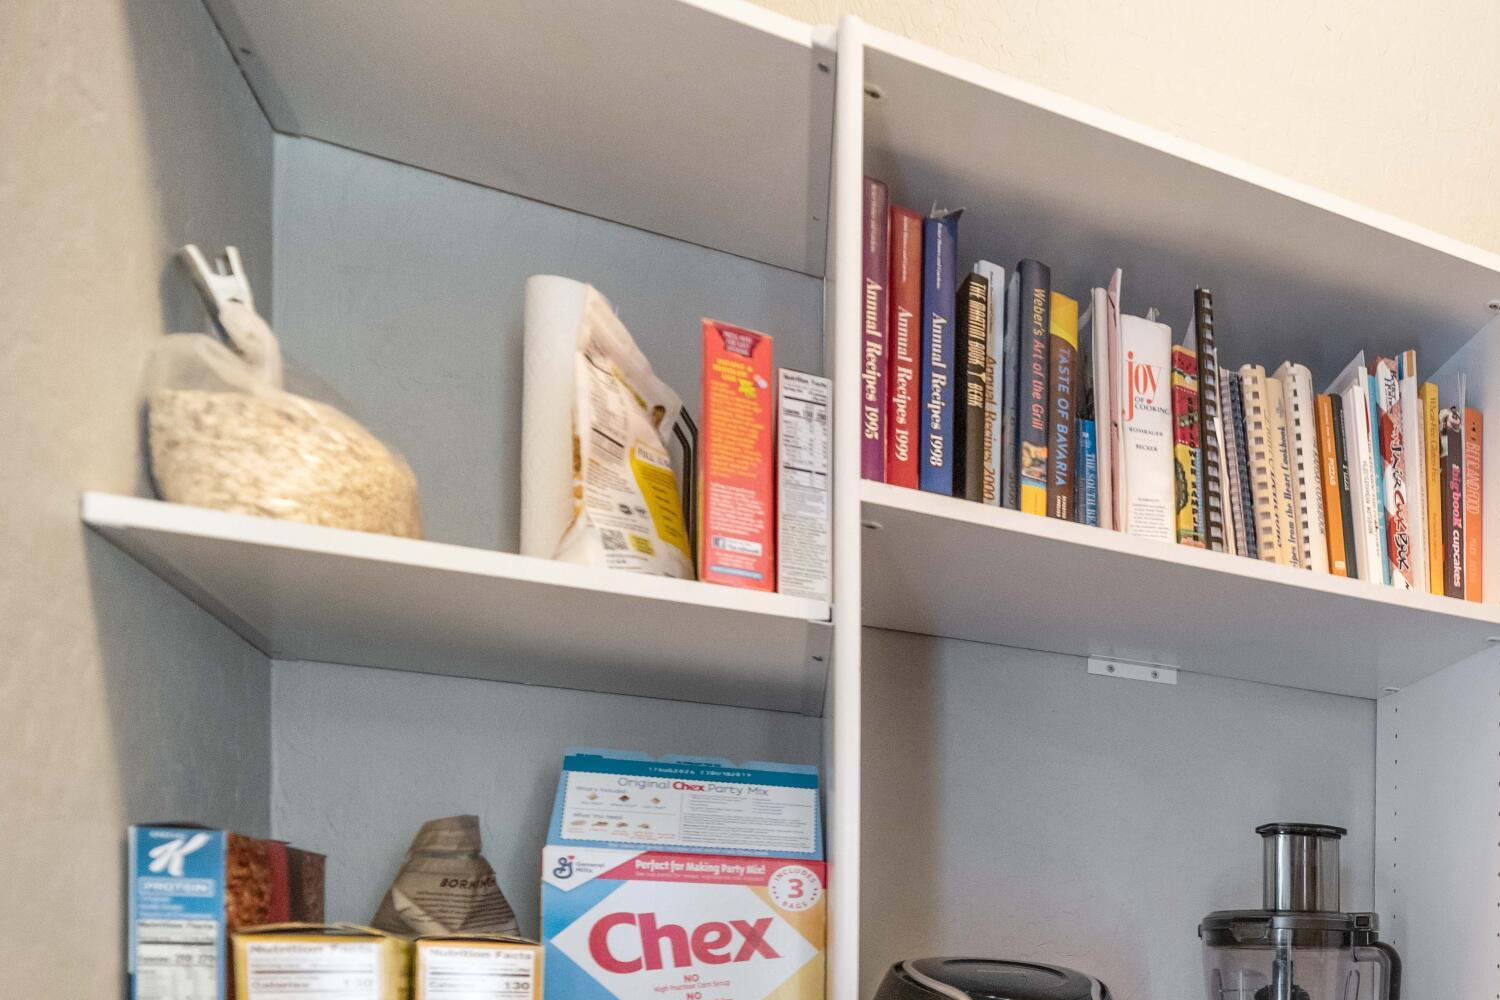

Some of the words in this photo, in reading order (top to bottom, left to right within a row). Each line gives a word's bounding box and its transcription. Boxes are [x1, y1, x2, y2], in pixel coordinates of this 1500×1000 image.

[865, 278, 883, 338] Annual
[969, 281, 986, 299] THE
[967, 299, 986, 339] MARTINI
[1032, 288, 1046, 336] Weber's
[897, 306, 913, 363] Annual
[931, 312, 948, 369] Annual
[1032, 338, 1045, 359] Art
[861, 340, 883, 402] Recipes
[967, 339, 985, 367] BOOK
[1032, 360, 1044, 377] of
[1057, 348, 1071, 394] TASTE
[892, 366, 913, 425] Recipes
[983, 356, 997, 405] Annual
[1031, 379, 1044, 400] the
[1123, 351, 1161, 422] joy
[927, 372, 947, 430] Recipes
[1031, 403, 1044, 431] Grill
[1056, 398, 1069, 420] OF
[864, 404, 880, 441] 1995
[895, 427, 910, 462] 1999
[929, 434, 944, 468] 1998
[1055, 423, 1069, 486] BAVARIA
[1452, 529, 1463, 588] cupcakes
[672, 781, 705, 792] Chex
[707, 783, 743, 796] Party
[747, 786, 769, 796] Mix
[634, 859, 670, 870] Perfect
[670, 862, 685, 873] for
[685, 862, 720, 875] Making
[720, 864, 746, 876] Party
[787, 878, 804, 899] 3
[588, 911, 784, 975] Chex
[504, 982, 531, 990] 130
[683, 973, 700, 982] NO
[687, 991, 702, 1000] NO
